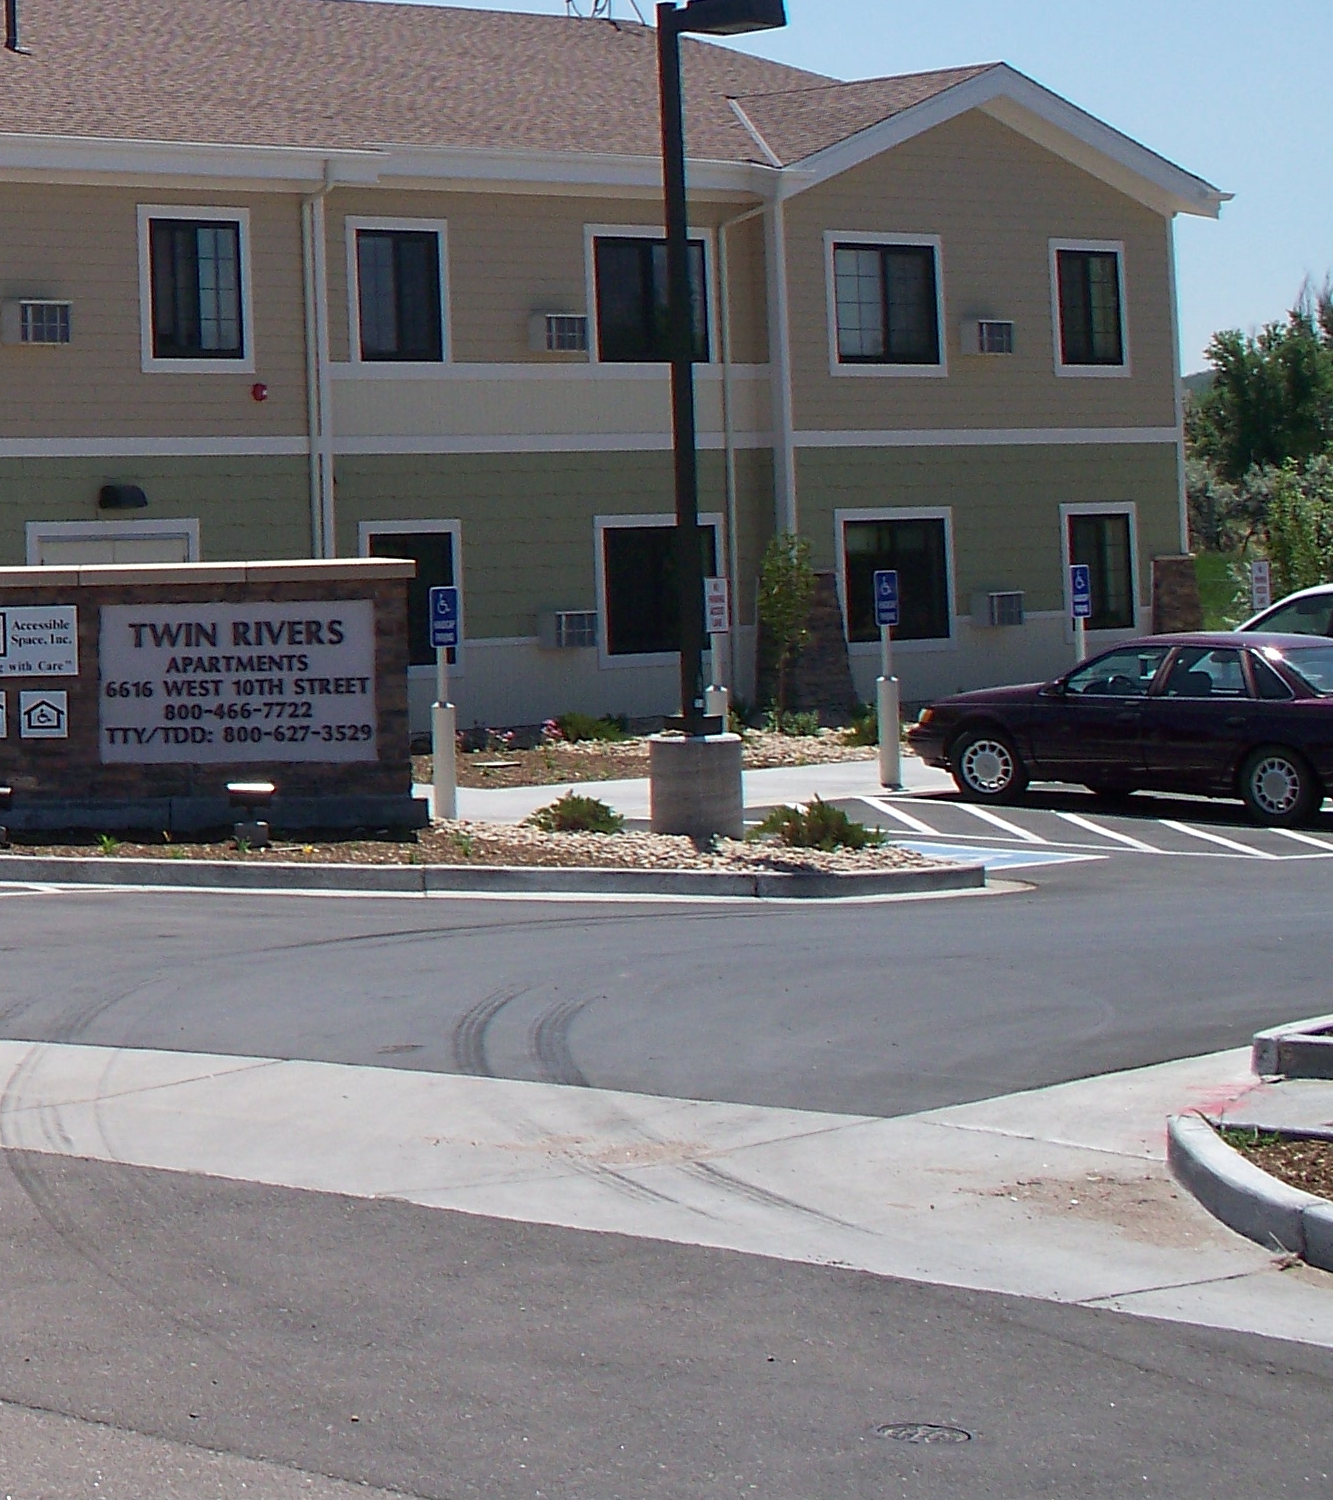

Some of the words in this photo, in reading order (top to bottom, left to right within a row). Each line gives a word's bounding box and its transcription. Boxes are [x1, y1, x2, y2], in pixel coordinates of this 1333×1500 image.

[12, 619, 71, 631] Accessible
[128, 622, 218, 648] TWIN
[231, 619, 345, 647] RIVERS
[50, 633, 72, 645] Inc.
[9, 662, 32, 671] with
[165, 654, 309, 674] APARTMENTS
[105, 681, 154, 698] 6616
[162, 679, 224, 697] WEST
[231, 678, 284, 696] 10TH
[294, 676, 370, 695] STREET
[164, 701, 313, 720] 800-466-7722
[105, 726, 214, 745] TTY/TDD:
[222, 723, 372, 743] 800-627-3529
